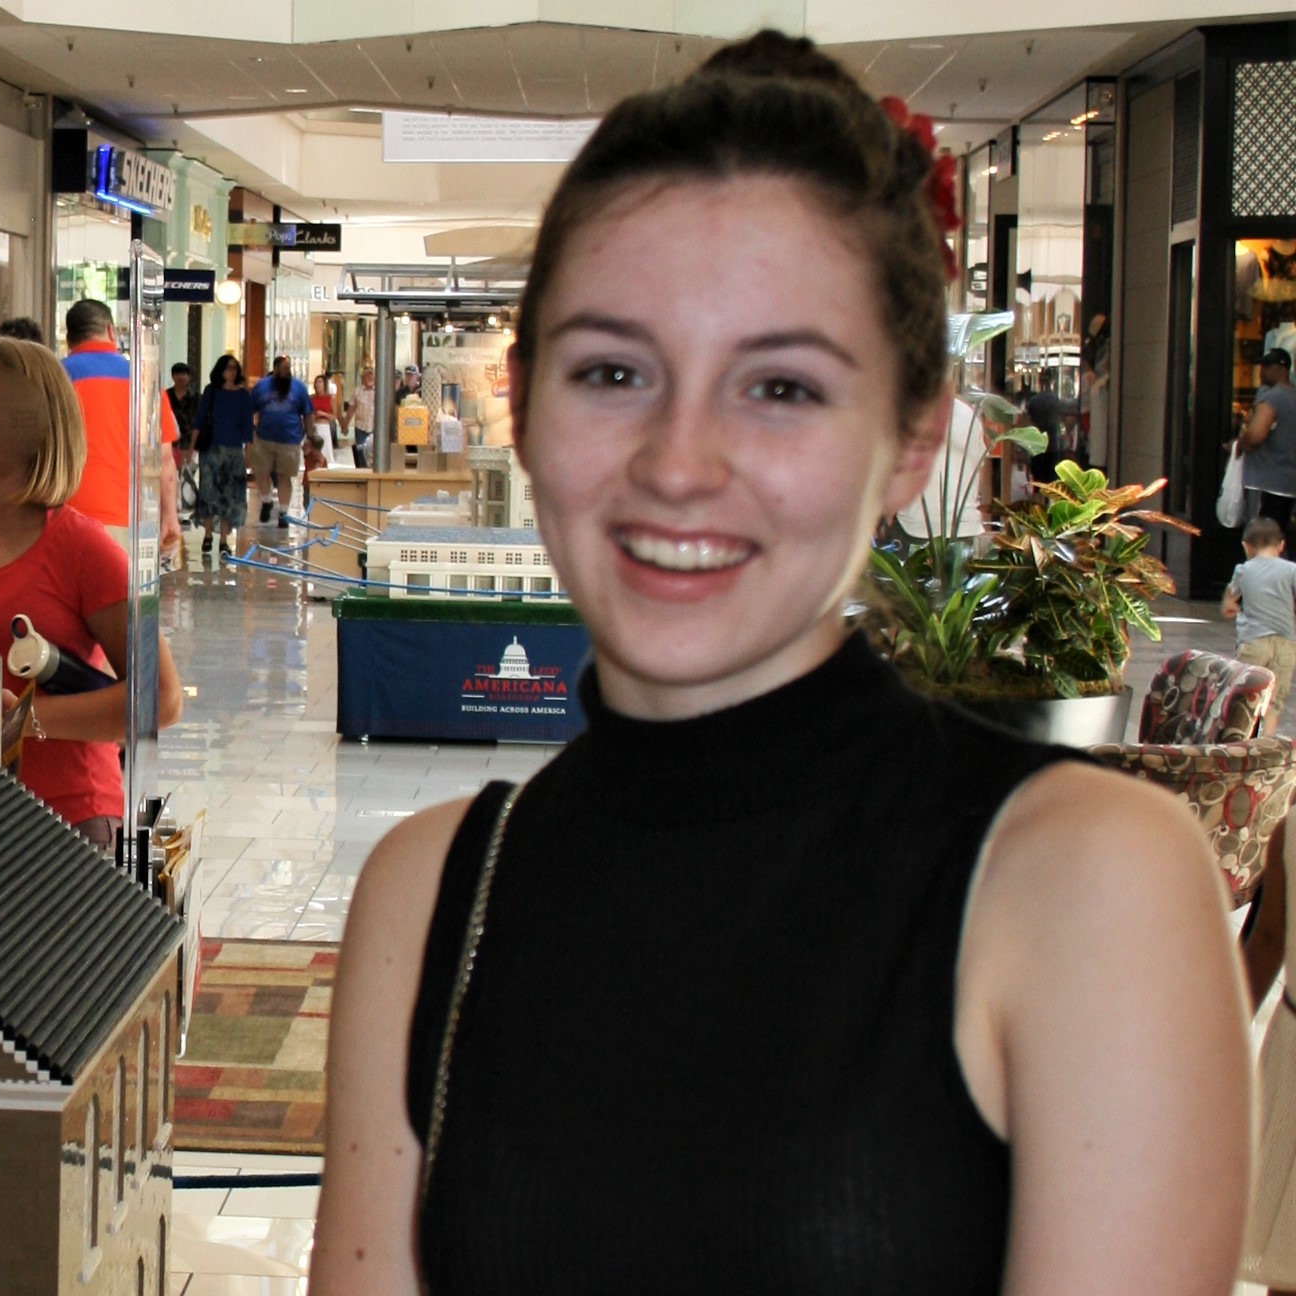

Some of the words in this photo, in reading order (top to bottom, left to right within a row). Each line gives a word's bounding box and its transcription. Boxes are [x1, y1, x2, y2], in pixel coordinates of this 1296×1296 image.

[121, 152, 177, 211] SKECHERS
[296, 230, 337, 244] Clarks
[164, 281, 210, 290] ECHERS
[462, 679, 567, 693] AMERICANA
[461, 705, 498, 713] BUILDING
[499, 706, 529, 714] ACROSS
[531, 706, 566, 715] AMERICA
